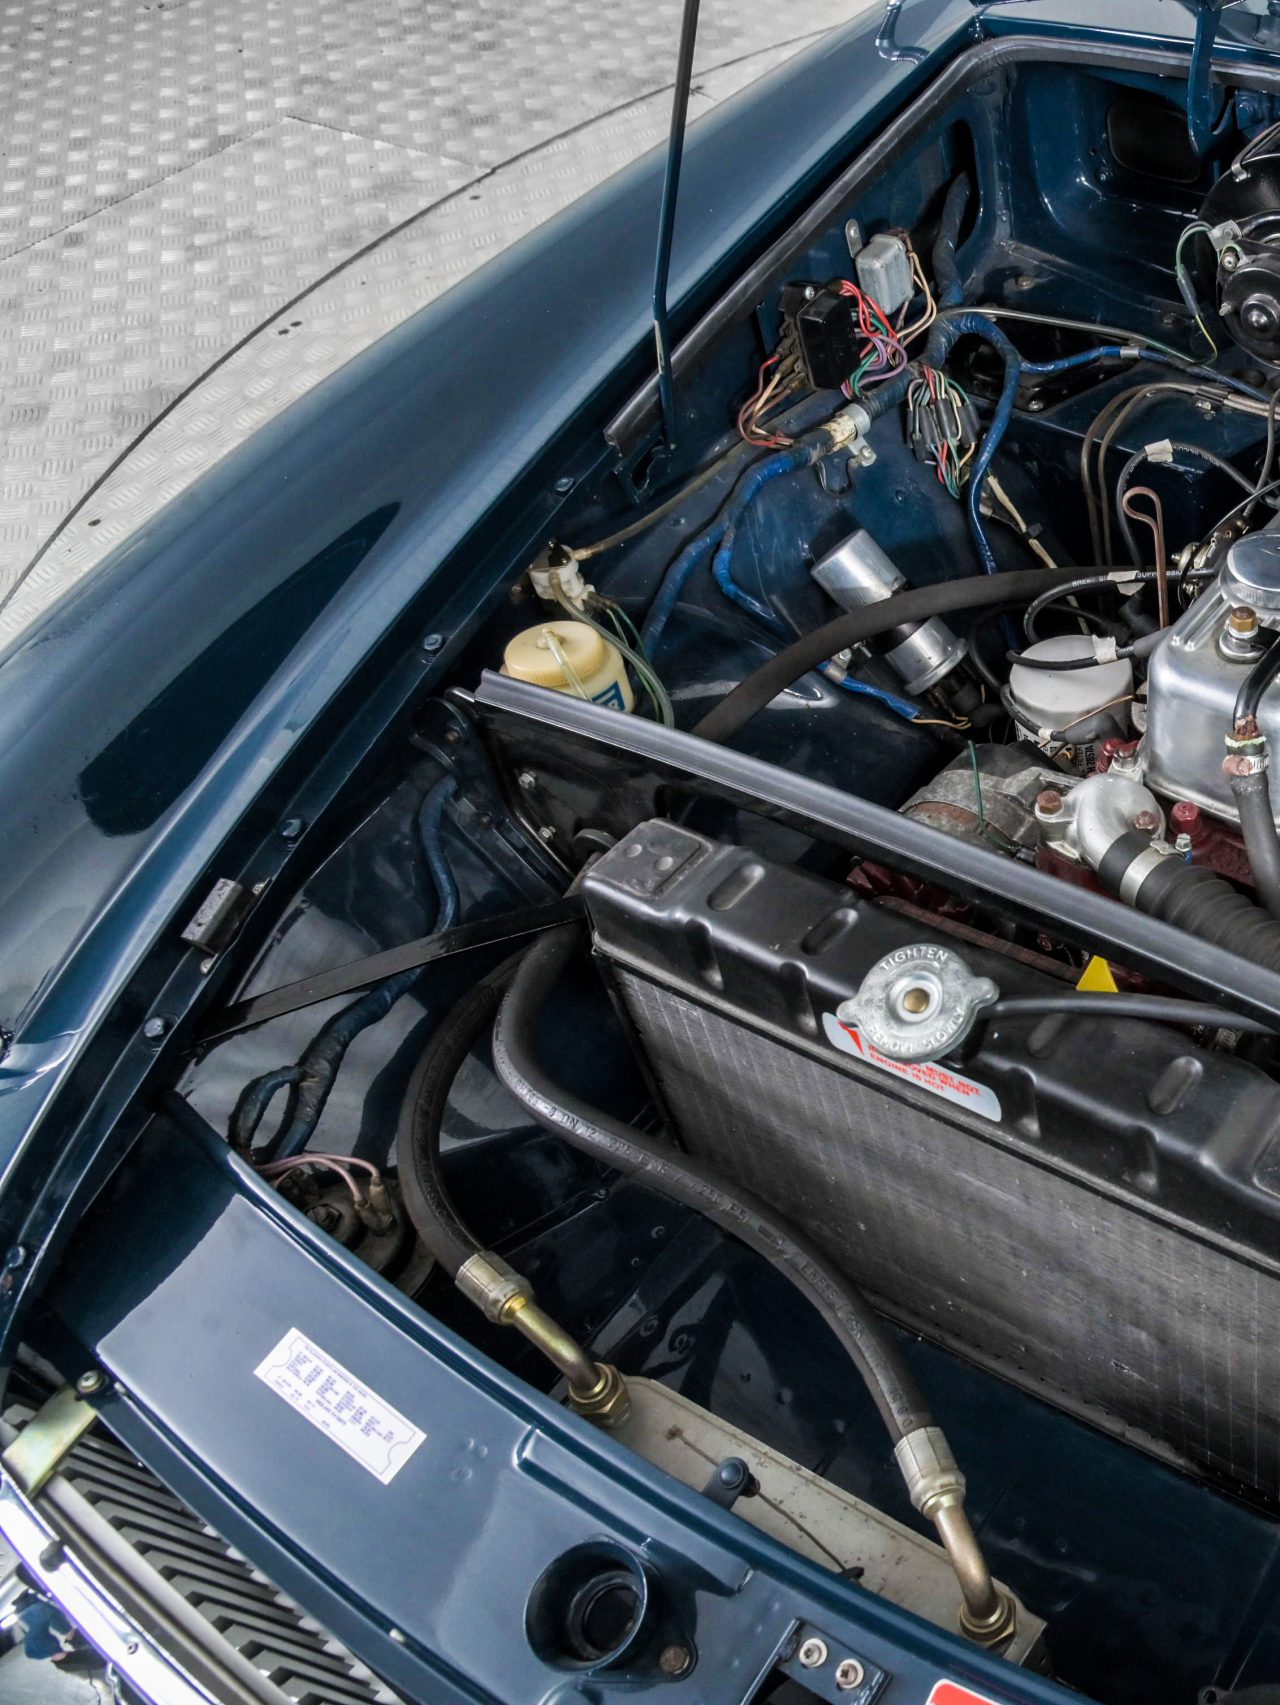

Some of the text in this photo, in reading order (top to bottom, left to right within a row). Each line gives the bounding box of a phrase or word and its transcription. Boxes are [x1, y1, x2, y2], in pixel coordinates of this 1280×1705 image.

[880, 946, 948, 971] TIGHTEN
[869, 1007, 965, 1053] REMOVE SLOWLY
[870, 1052, 945, 1091] ENGINE IS HOT
[925, 1064, 955, 1082] MUST
[940, 1078, 970, 1096] WHEN
[584, 1125, 598, 1138] 12
